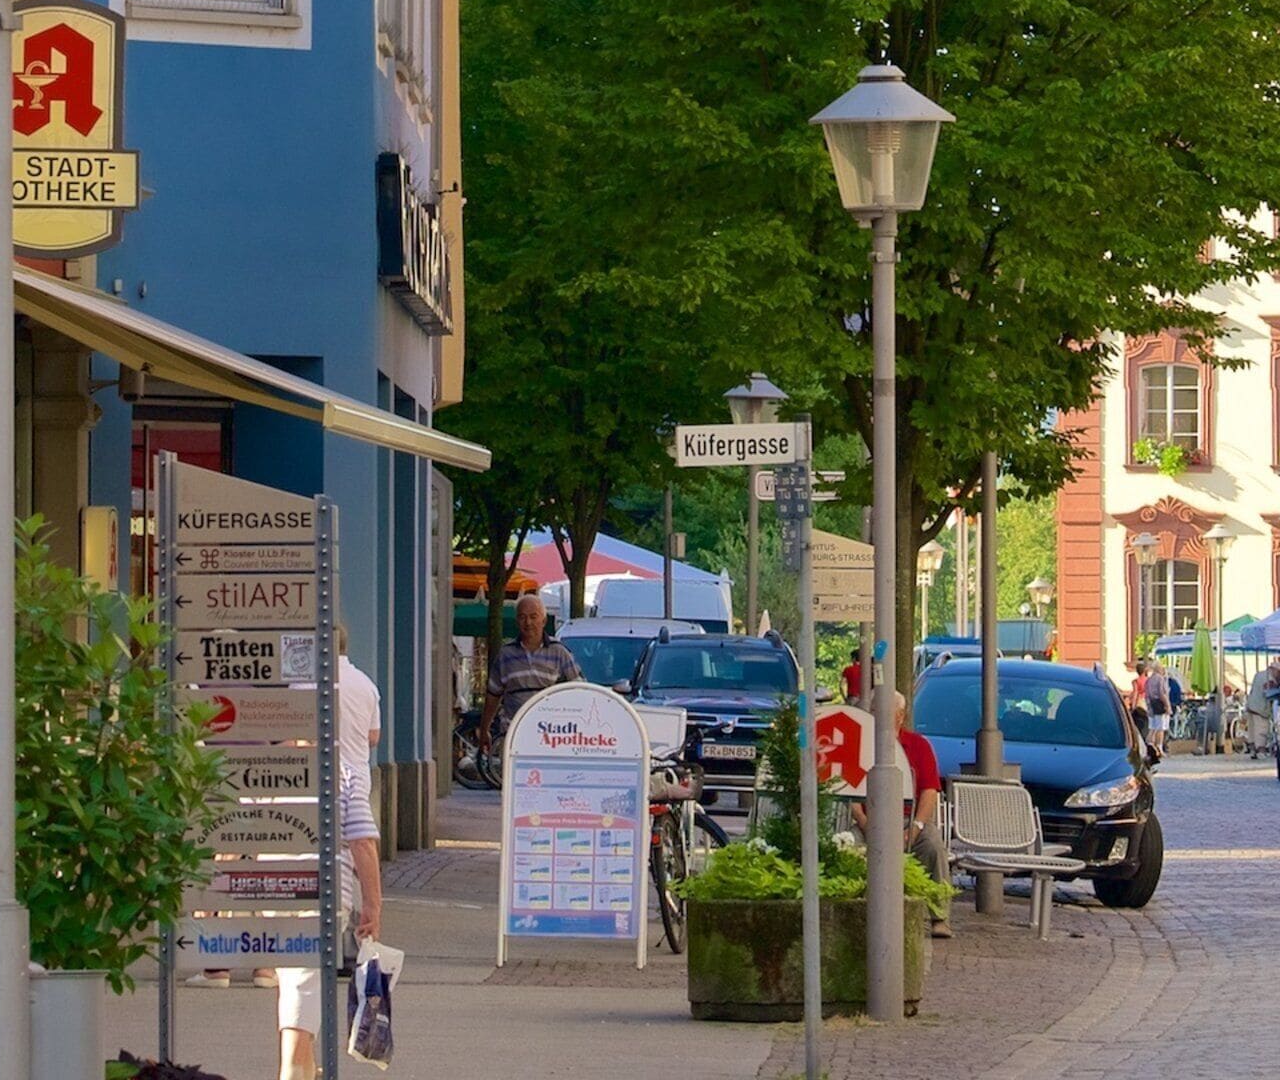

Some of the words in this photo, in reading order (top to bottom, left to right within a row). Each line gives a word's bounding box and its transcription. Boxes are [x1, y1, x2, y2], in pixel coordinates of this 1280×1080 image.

[27, 156, 116, 178] STADT-
[684, 433, 789, 462] Küfergasse
[178, 509, 312, 529] KÜFERGASSE
[207, 583, 310, 609] stilART
[200, 637, 274, 658] Tinten
[204, 659, 272, 680] Fässle
[537, 720, 579, 734] Stadt
[540, 731, 618, 748] Apotheke
[243, 768, 310, 789] Gürsel
[221, 833, 294, 842] RESTAURANT
[269, 810, 320, 846] TAVERNE
[231, 877, 319, 889] HIGHSCORE
[198, 932, 320, 954] NaturSalzLaden
